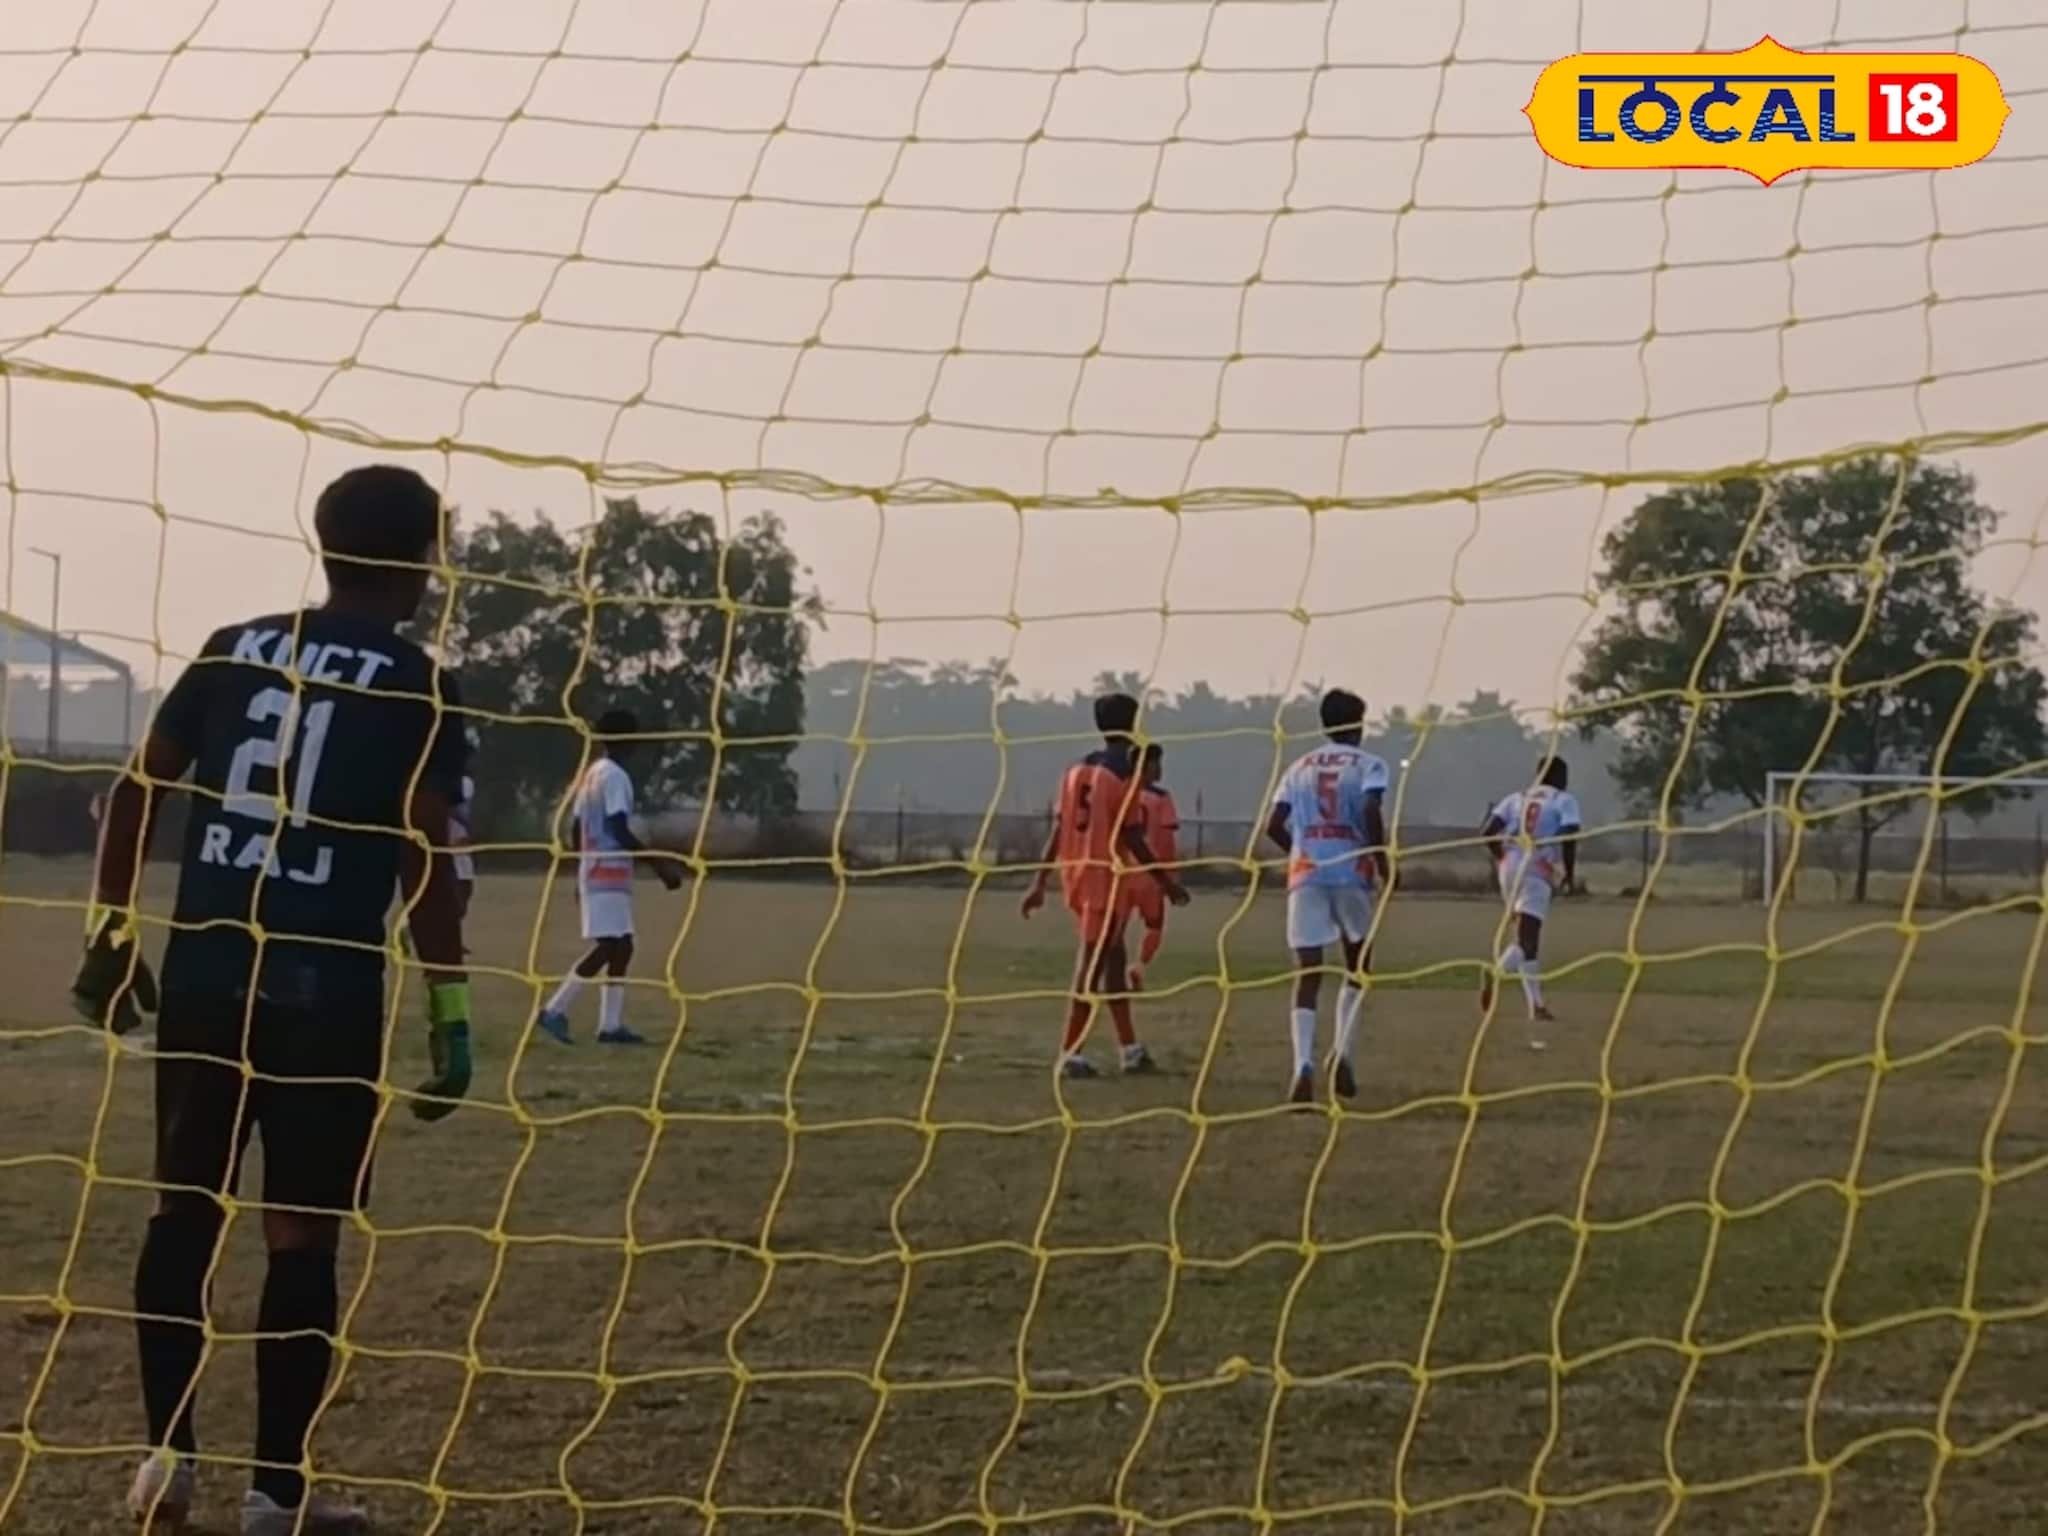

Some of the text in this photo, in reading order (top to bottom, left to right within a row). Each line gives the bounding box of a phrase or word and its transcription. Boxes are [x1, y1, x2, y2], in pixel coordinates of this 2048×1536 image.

[222, 686, 335, 829] 21
[1317, 772, 1340, 820] 5
[199, 823, 334, 885] RAJ
